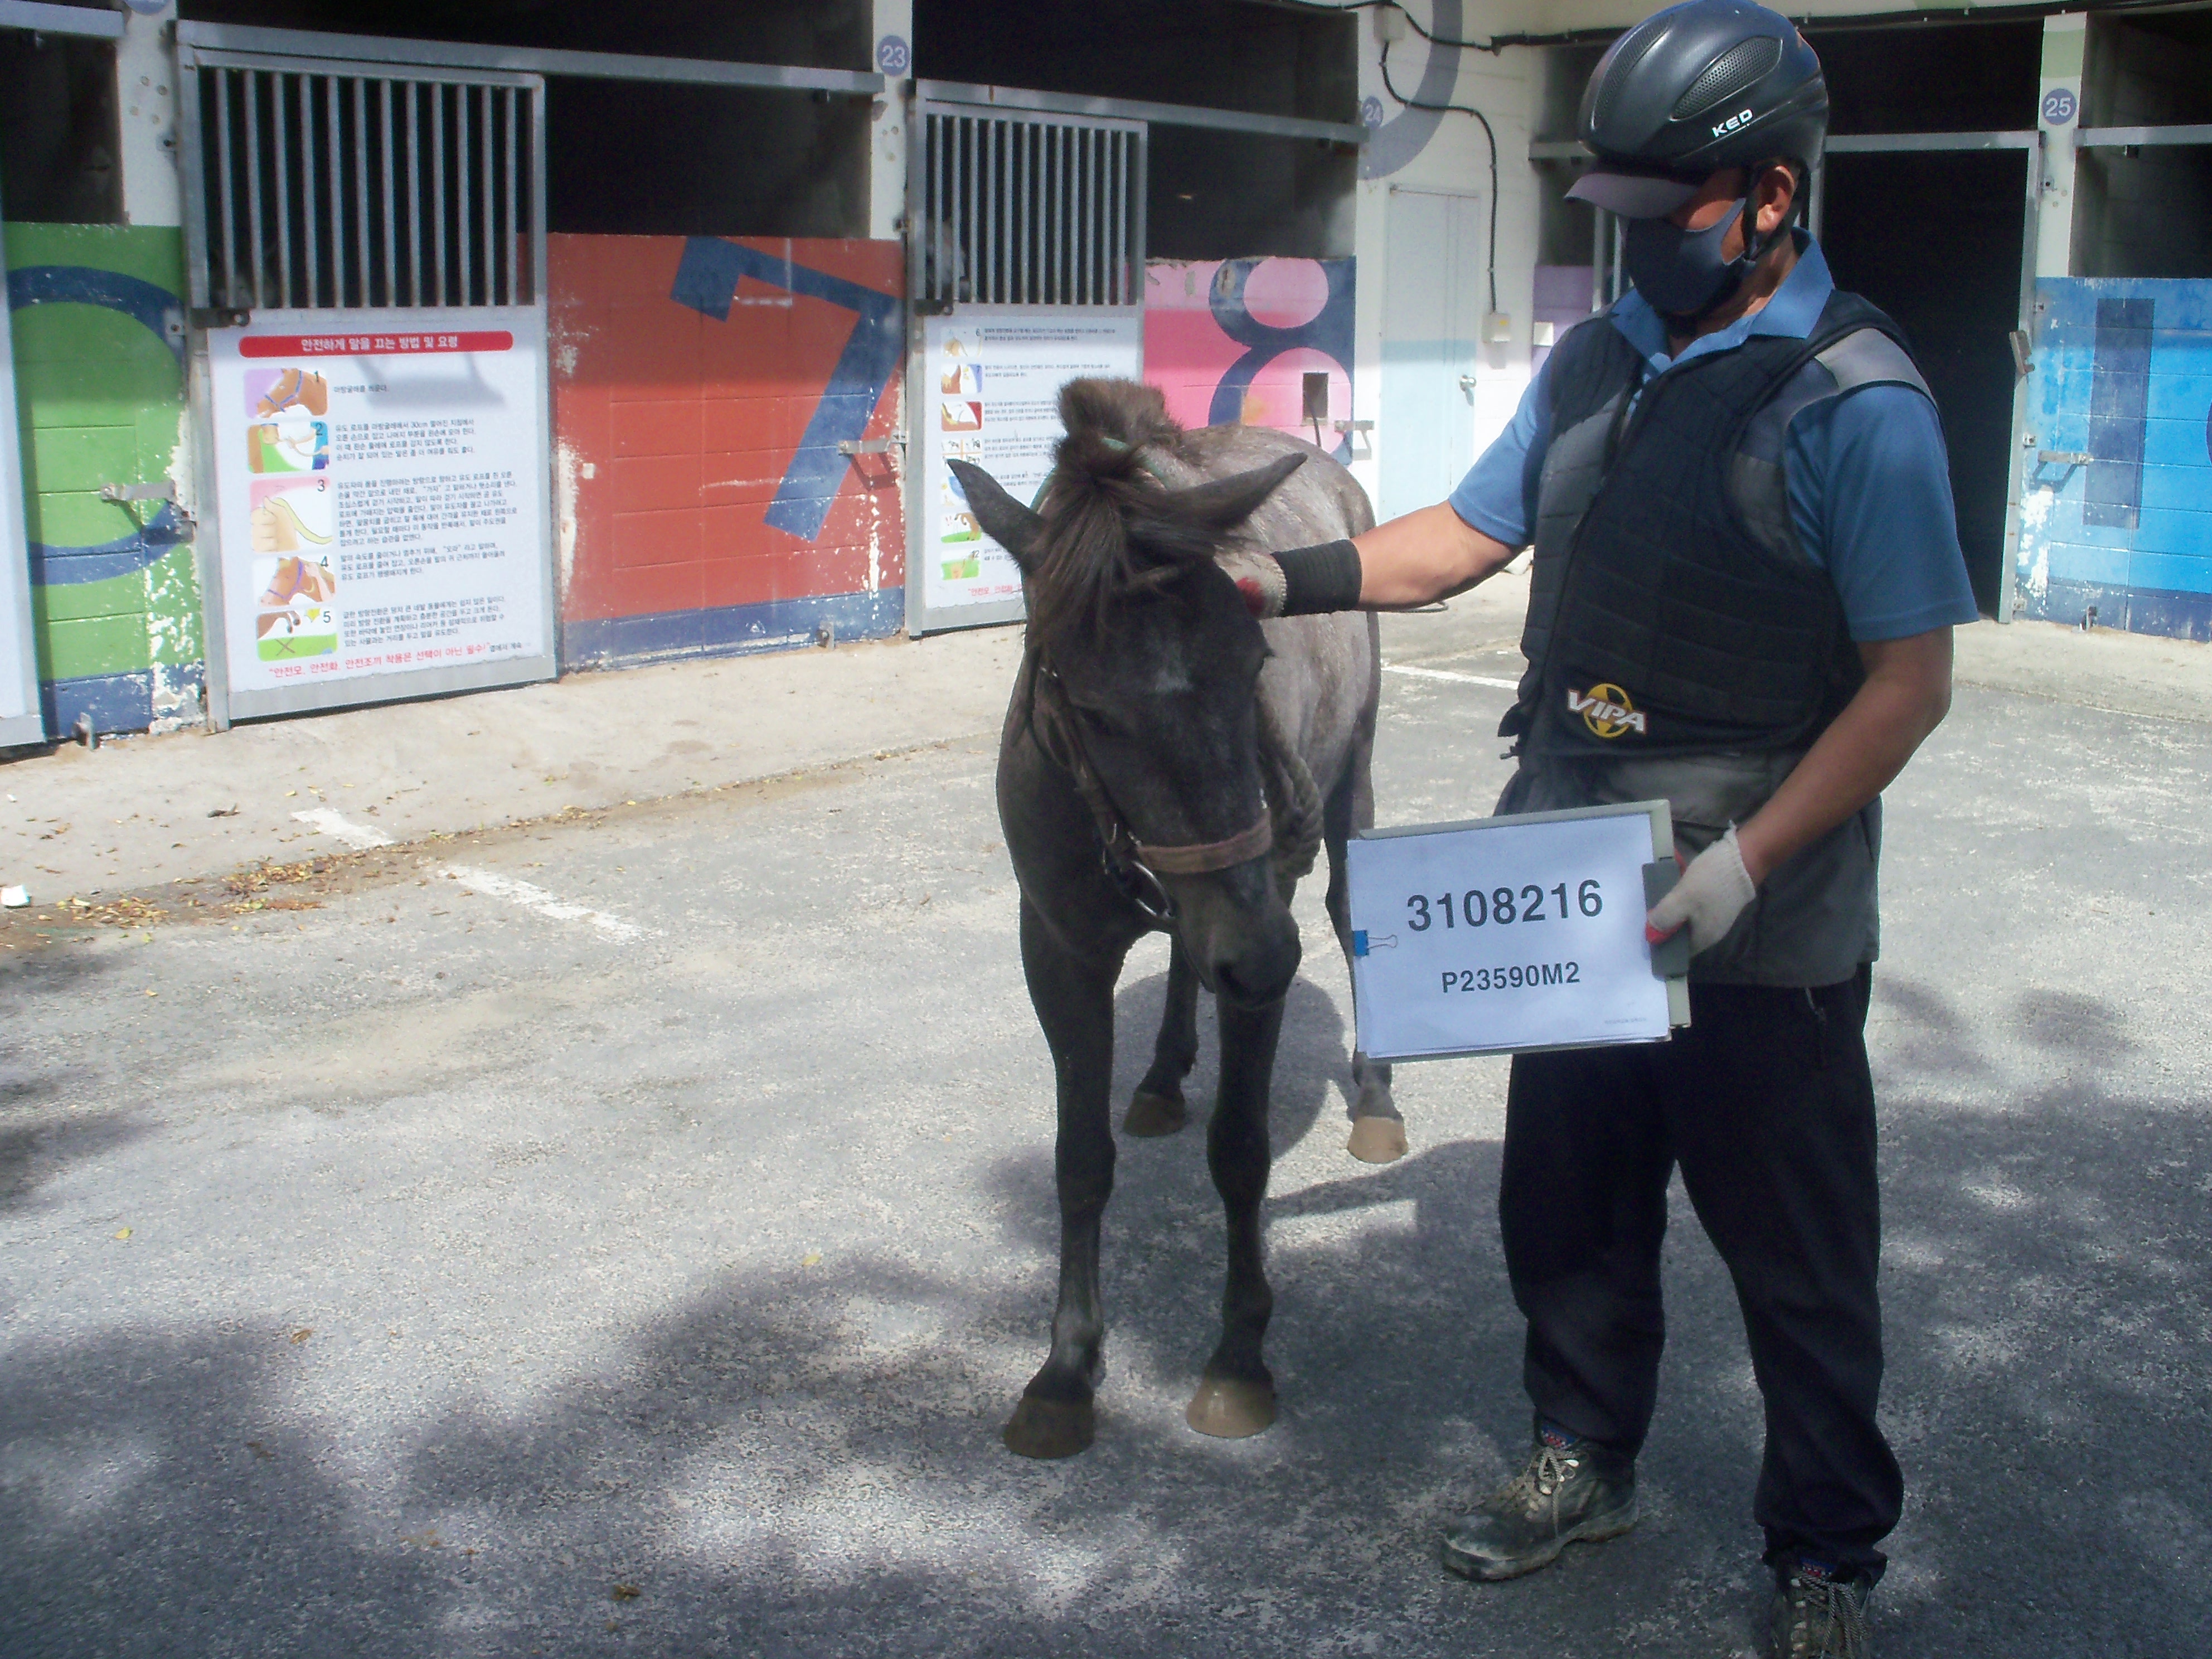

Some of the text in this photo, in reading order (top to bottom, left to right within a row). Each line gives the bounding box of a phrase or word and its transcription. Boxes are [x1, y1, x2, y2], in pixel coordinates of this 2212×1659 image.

[882, 45, 905, 67] 23
[2045, 96, 2072, 118] 25
[1711, 109, 1753, 138] KED
[302, 335, 458, 352] 안전하게 말을 끄는 방법 및 요령
[316, 422, 323, 436] 2
[317, 479, 326, 492] 3
[321, 556, 329, 567] 4
[323, 610, 331, 623] 5
[345, 656, 382, 669] 안전조끼
[417, 649, 442, 661] 선택이
[445, 647, 463, 657] 아닌
[1568, 690, 1645, 734] VIPA
[1406, 879, 1604, 933] 3108216
[1441, 961, 1581, 993] P23590M2
